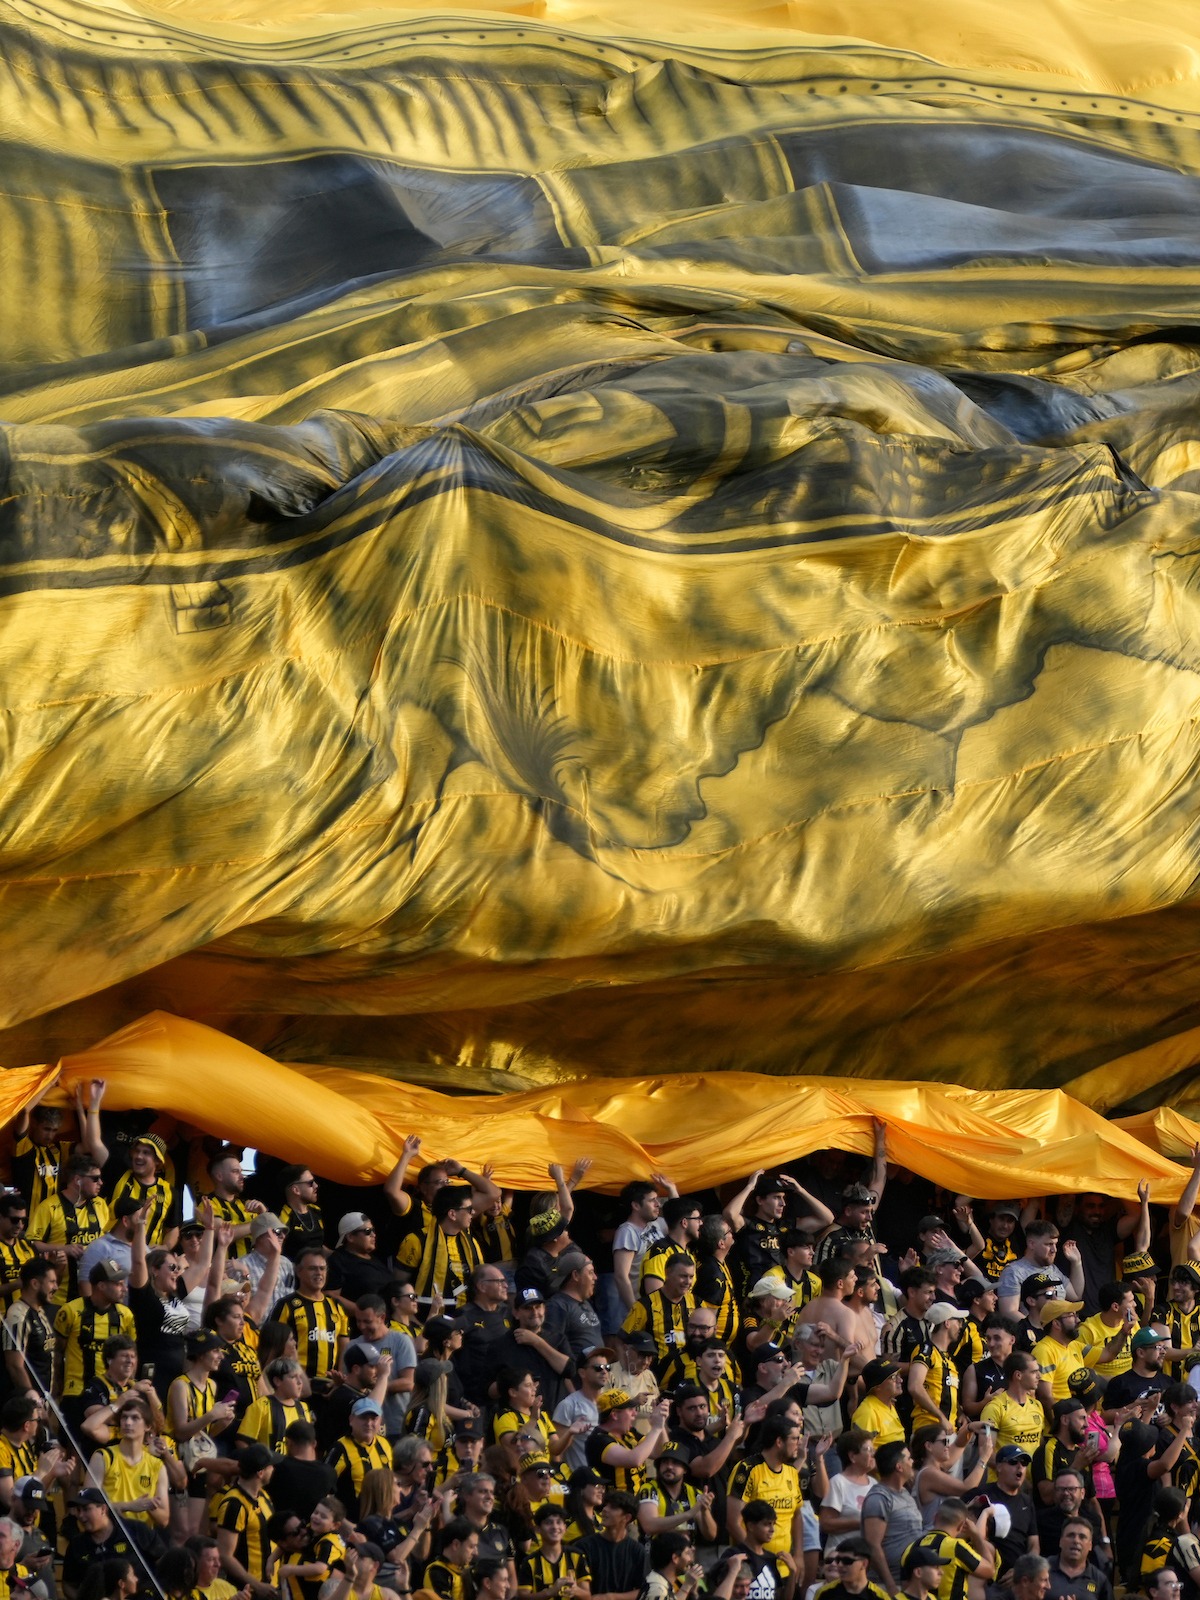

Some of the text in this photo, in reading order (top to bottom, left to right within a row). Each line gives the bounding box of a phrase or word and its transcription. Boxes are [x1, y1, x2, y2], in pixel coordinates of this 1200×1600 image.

[759, 1236, 781, 1250] ant
[769, 1496, 793, 1509] antel
[746, 1586, 775, 1600] adid
